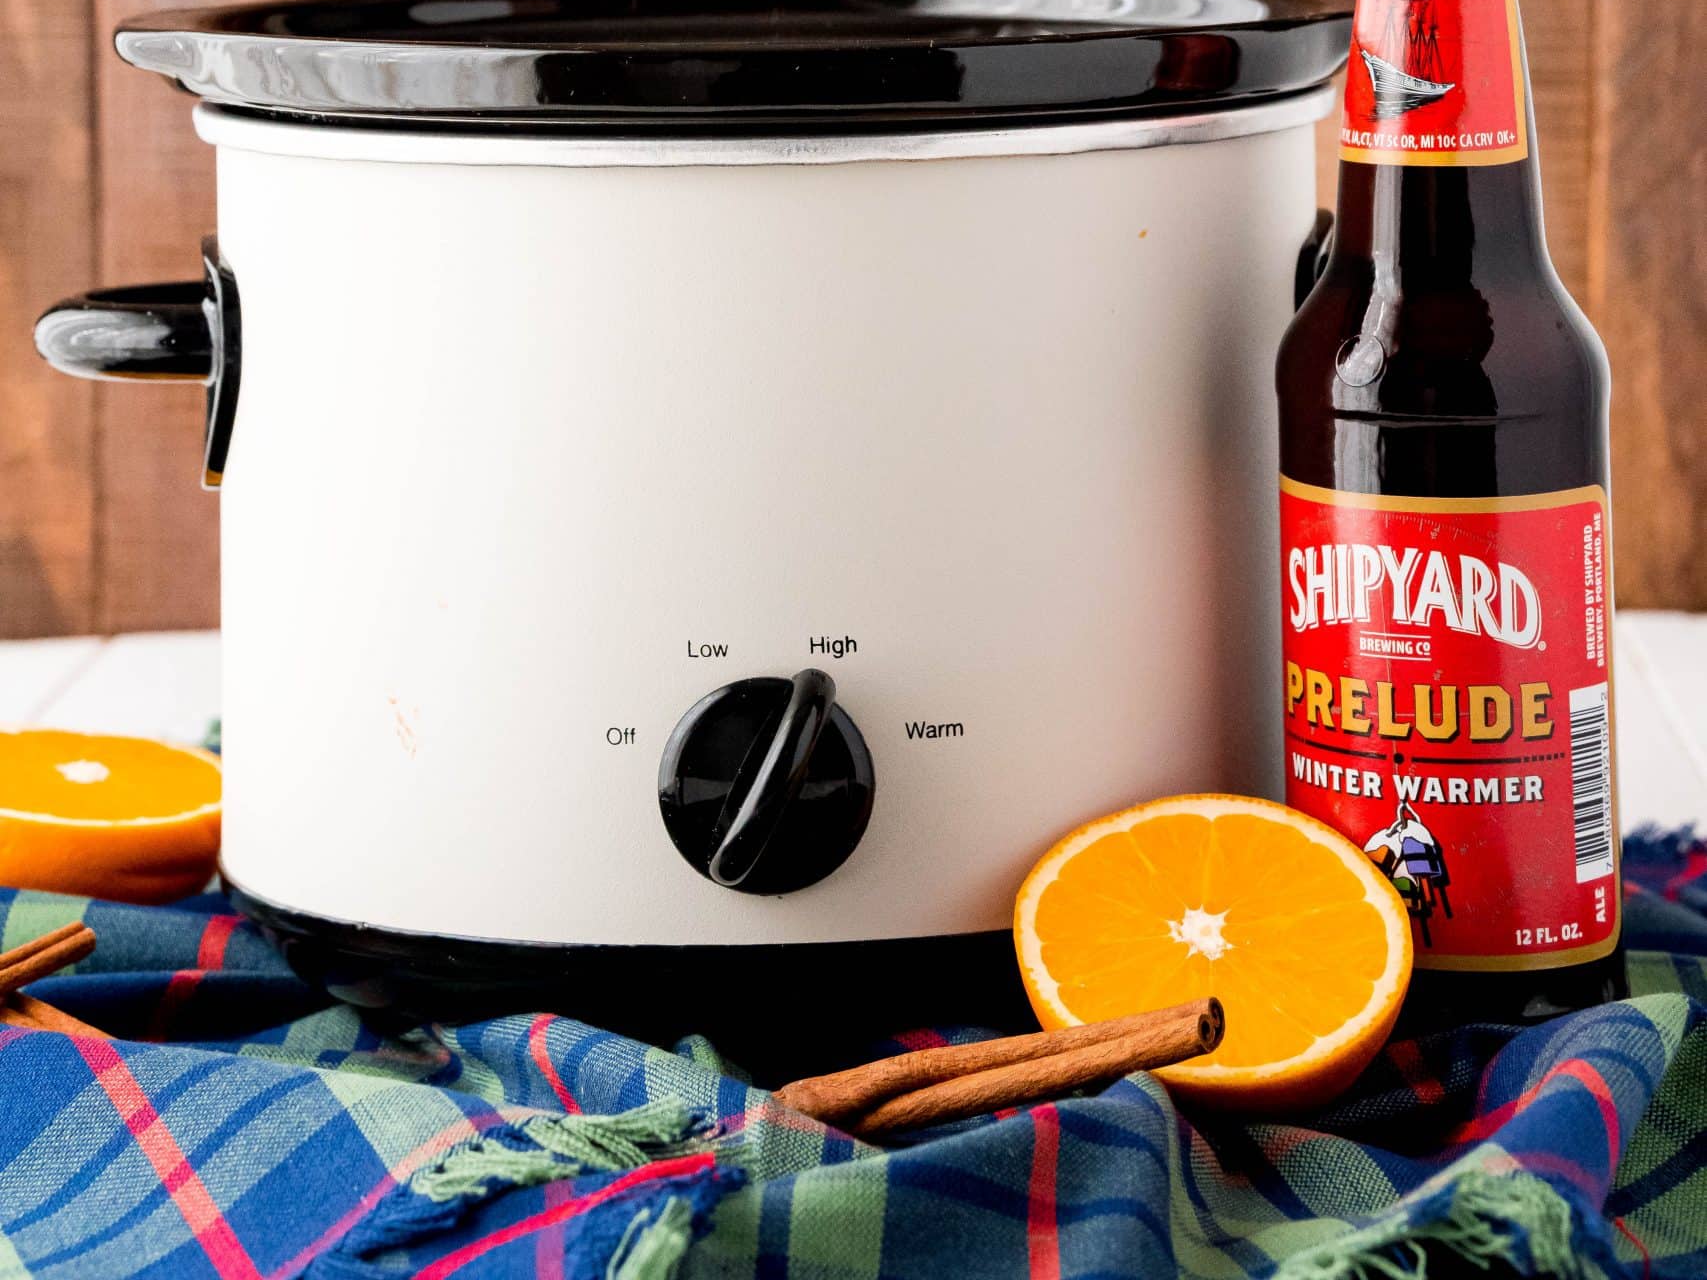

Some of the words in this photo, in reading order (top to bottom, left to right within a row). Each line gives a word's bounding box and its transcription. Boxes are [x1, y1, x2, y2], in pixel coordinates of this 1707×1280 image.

[1374, 133, 1385, 147] VT
[1400, 134, 1418, 150] OR,
[1420, 135, 1434, 149] MI
[1459, 133, 1473, 147] CA
[1474, 132, 1493, 146] CRV
[1497, 130, 1516, 145] OK+
[1593, 512, 1602, 532] ME
[1584, 525, 1594, 586] SHIPYARD
[1595, 534, 1604, 602] PORTLAND,
[1288, 543, 1542, 650] SHIPYARD
[1585, 589, 1595, 605] BY
[1359, 637, 1413, 655] BREWING
[1586, 608, 1596, 660] BREWED
[1595, 605, 1605, 668] BREWERY,
[687, 640, 729, 658] Low
[809, 636, 858, 659] High
[1287, 660, 1554, 741] PRELUDE
[606, 727, 637, 745] Off
[905, 721, 964, 740] Warm
[1292, 752, 1382, 798] WINTER
[1394, 775, 1544, 803] WARMER
[1594, 886, 1606, 922] ALE
[1515, 929, 1532, 946] 12
[1536, 927, 1558, 944] FL.
[1561, 922, 1583, 941] OZ.
